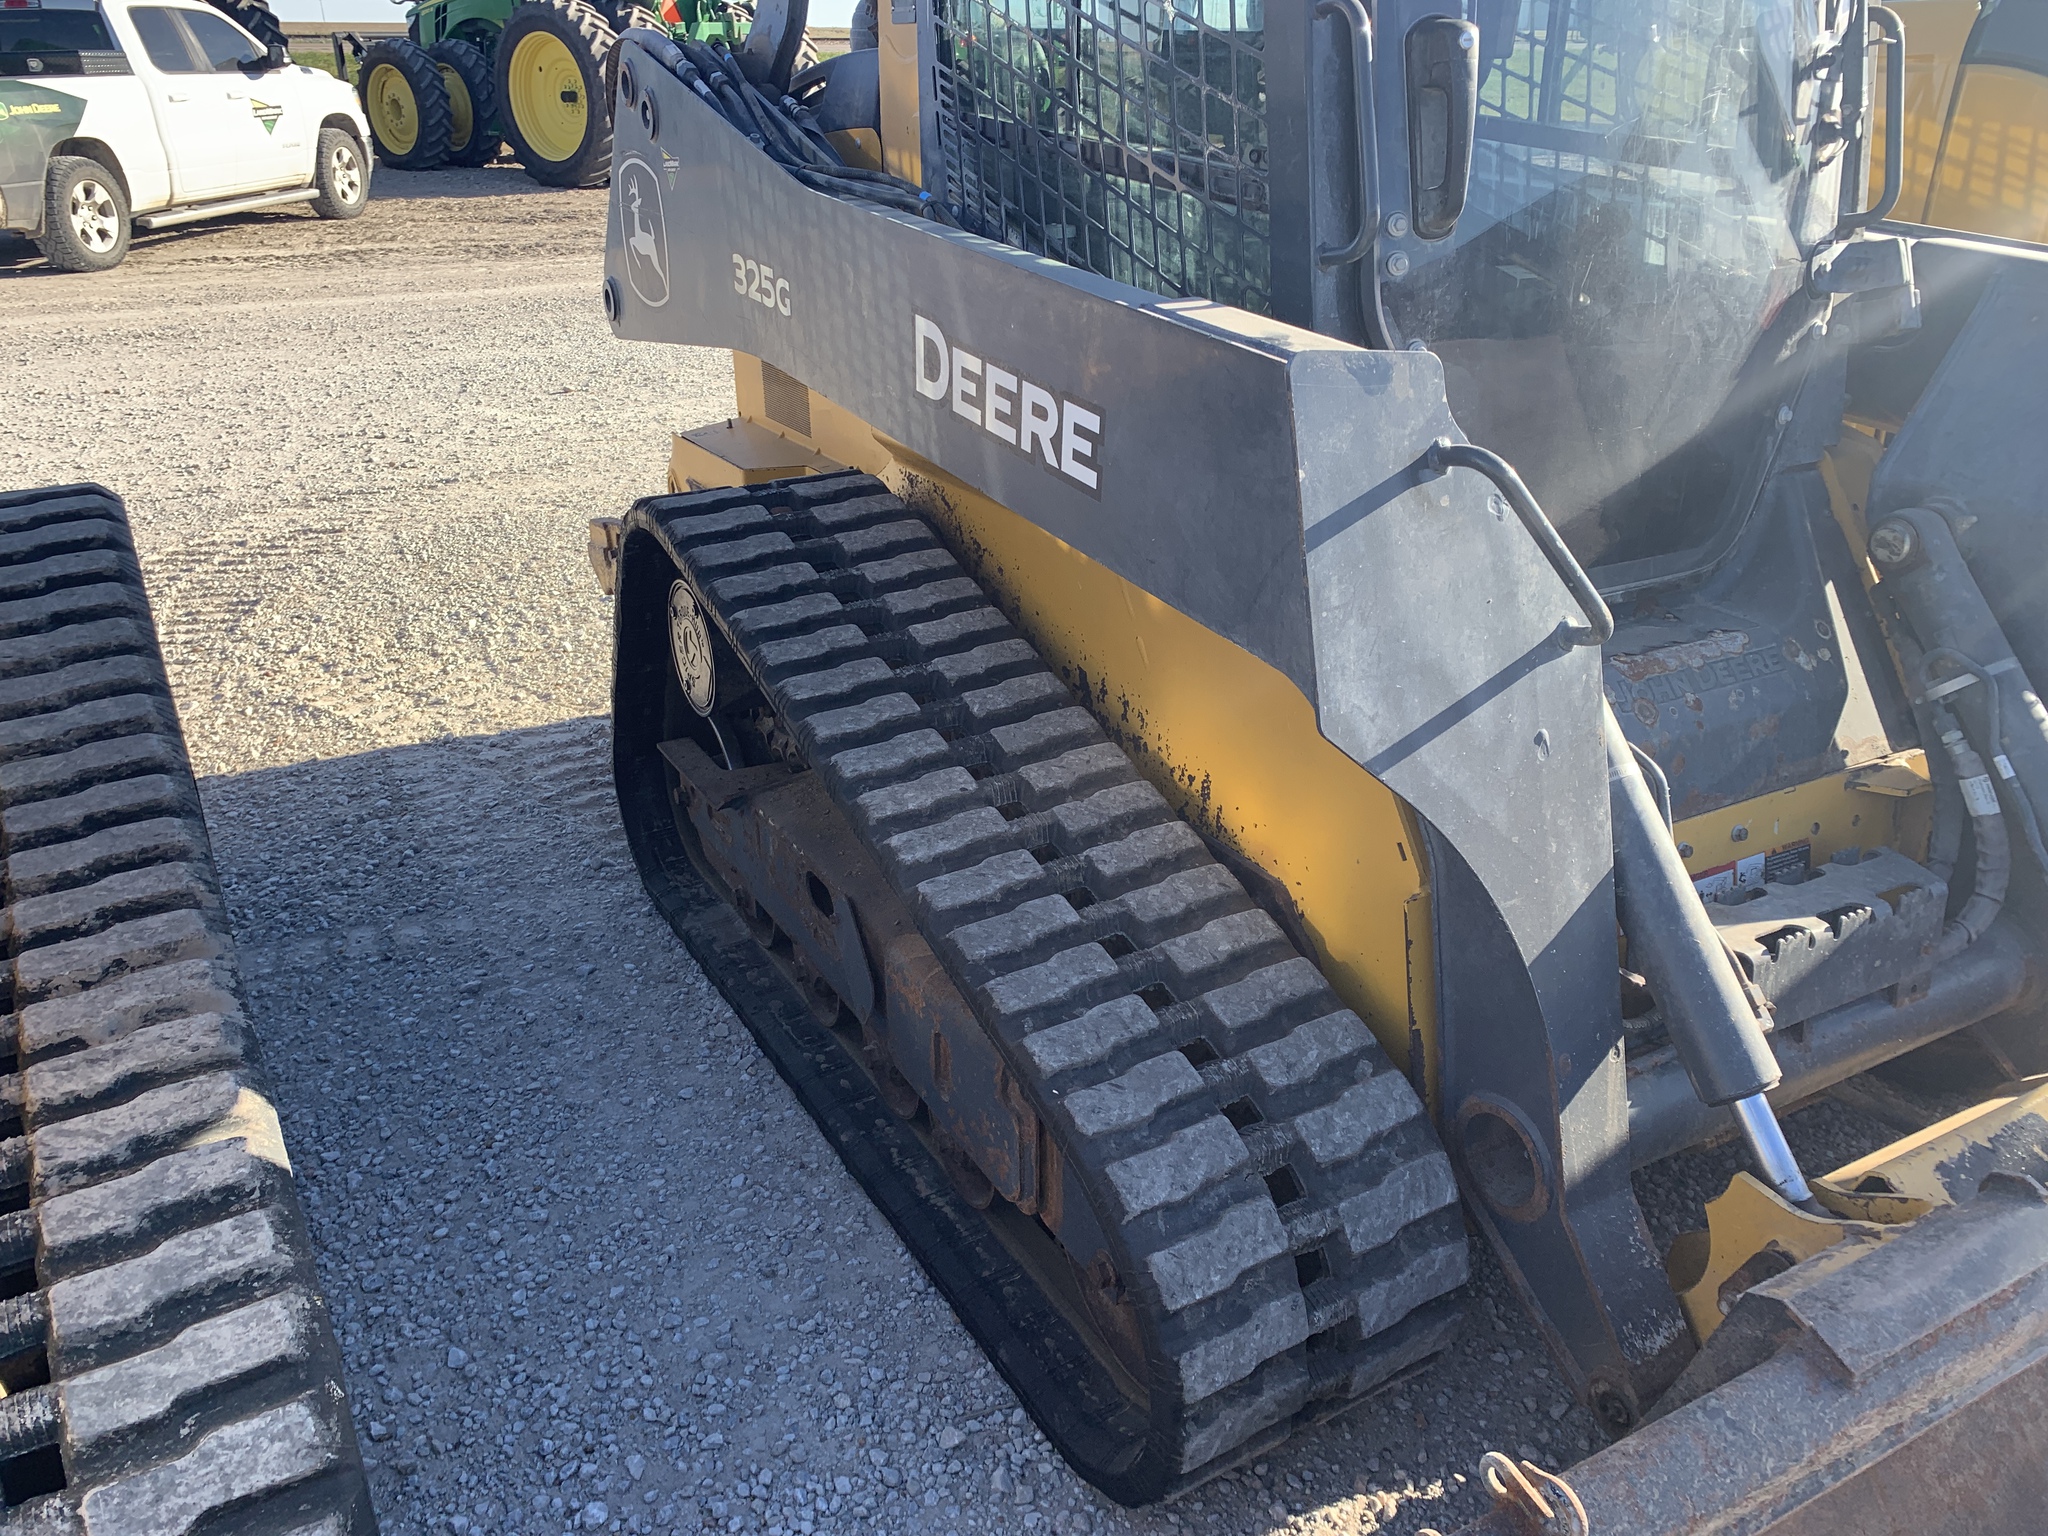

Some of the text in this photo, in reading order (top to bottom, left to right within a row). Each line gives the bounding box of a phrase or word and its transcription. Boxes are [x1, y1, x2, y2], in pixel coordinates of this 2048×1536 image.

[9, 103, 61, 116] JOHN DEERE
[732, 253, 791, 317] 325G
[915, 314, 1101, 490] DEERE
[1615, 650, 1788, 713] JOHN DEERE
